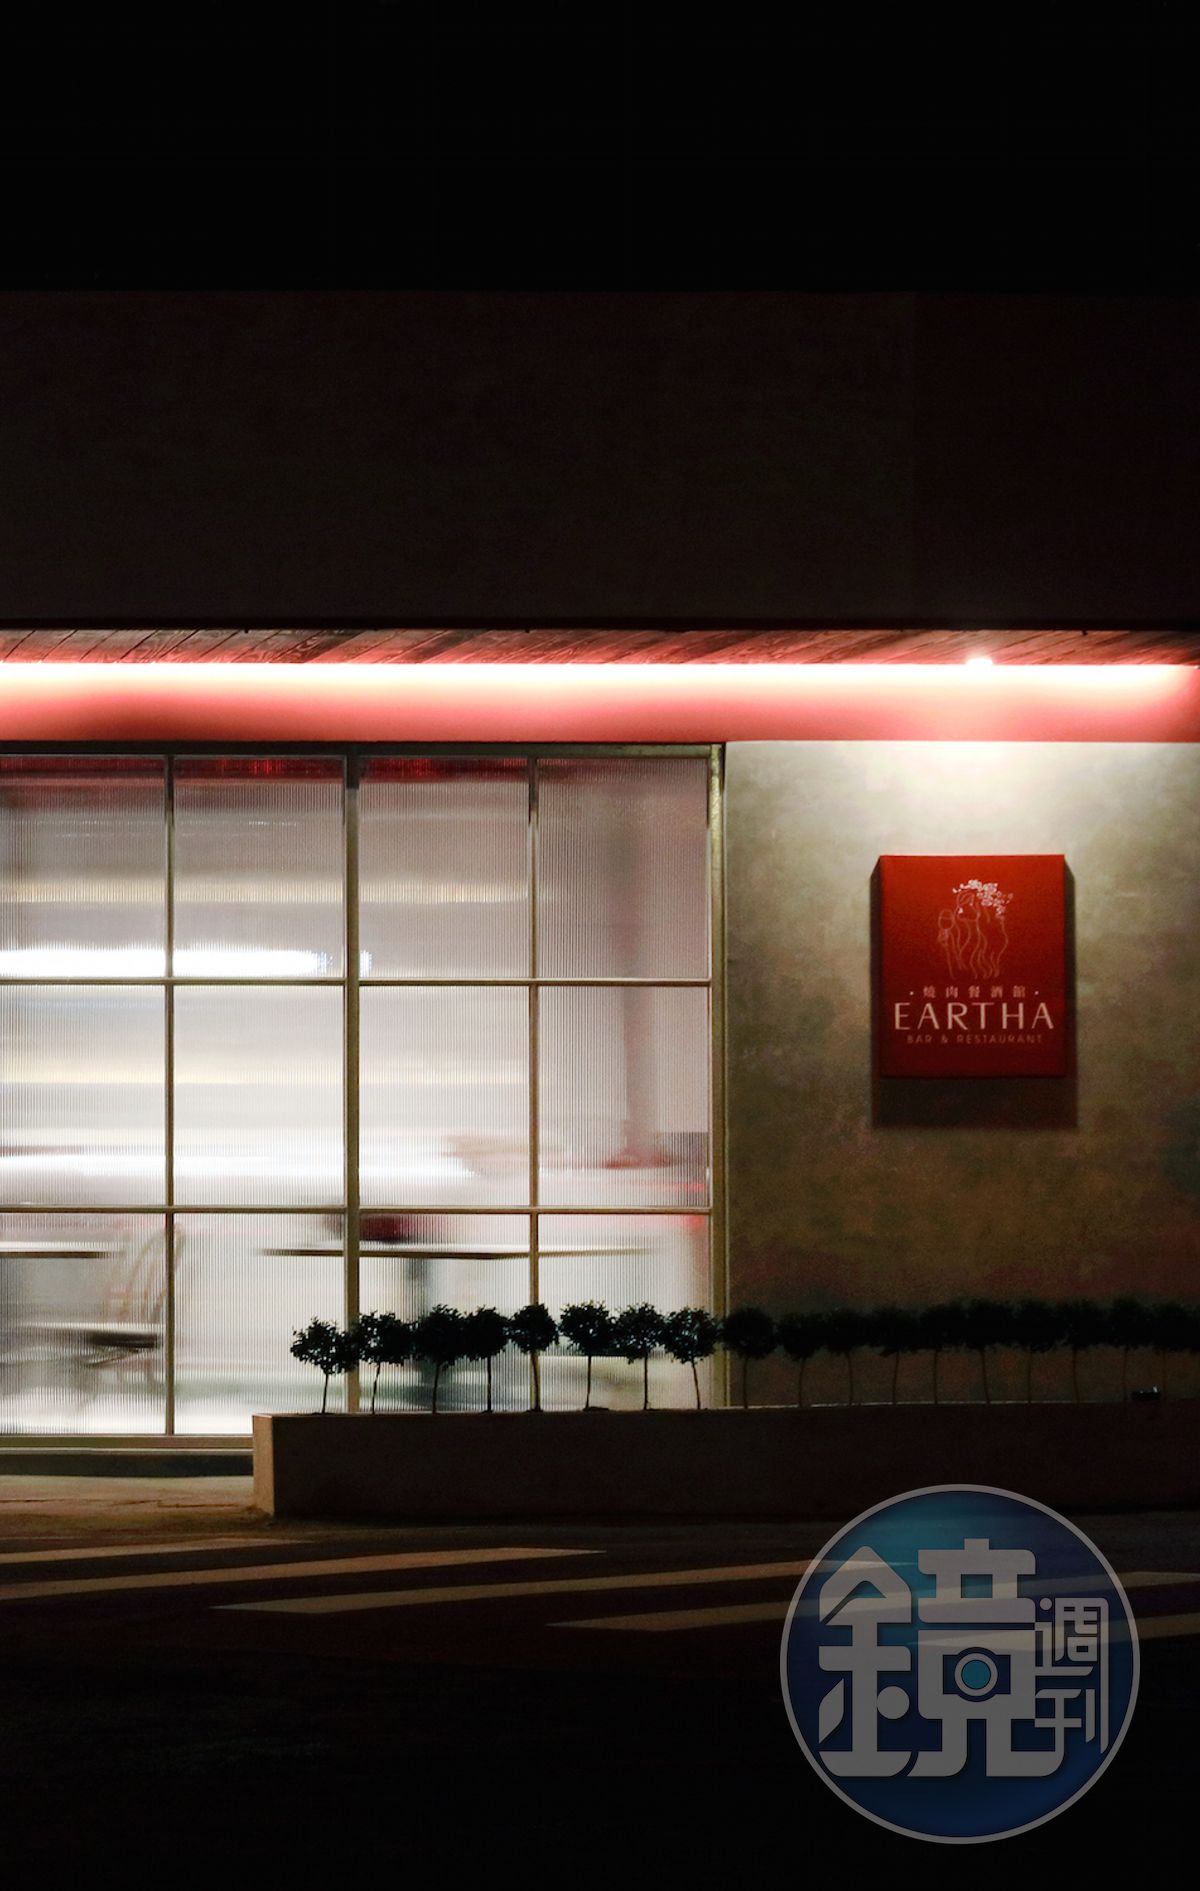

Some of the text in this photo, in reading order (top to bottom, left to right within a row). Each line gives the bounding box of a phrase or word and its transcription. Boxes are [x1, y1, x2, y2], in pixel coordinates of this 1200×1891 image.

[894, 1002, 1055, 1030] EARTHA
[907, 1034, 933, 1045] BAR
[956, 1034, 1043, 1044] RESTAURANT
